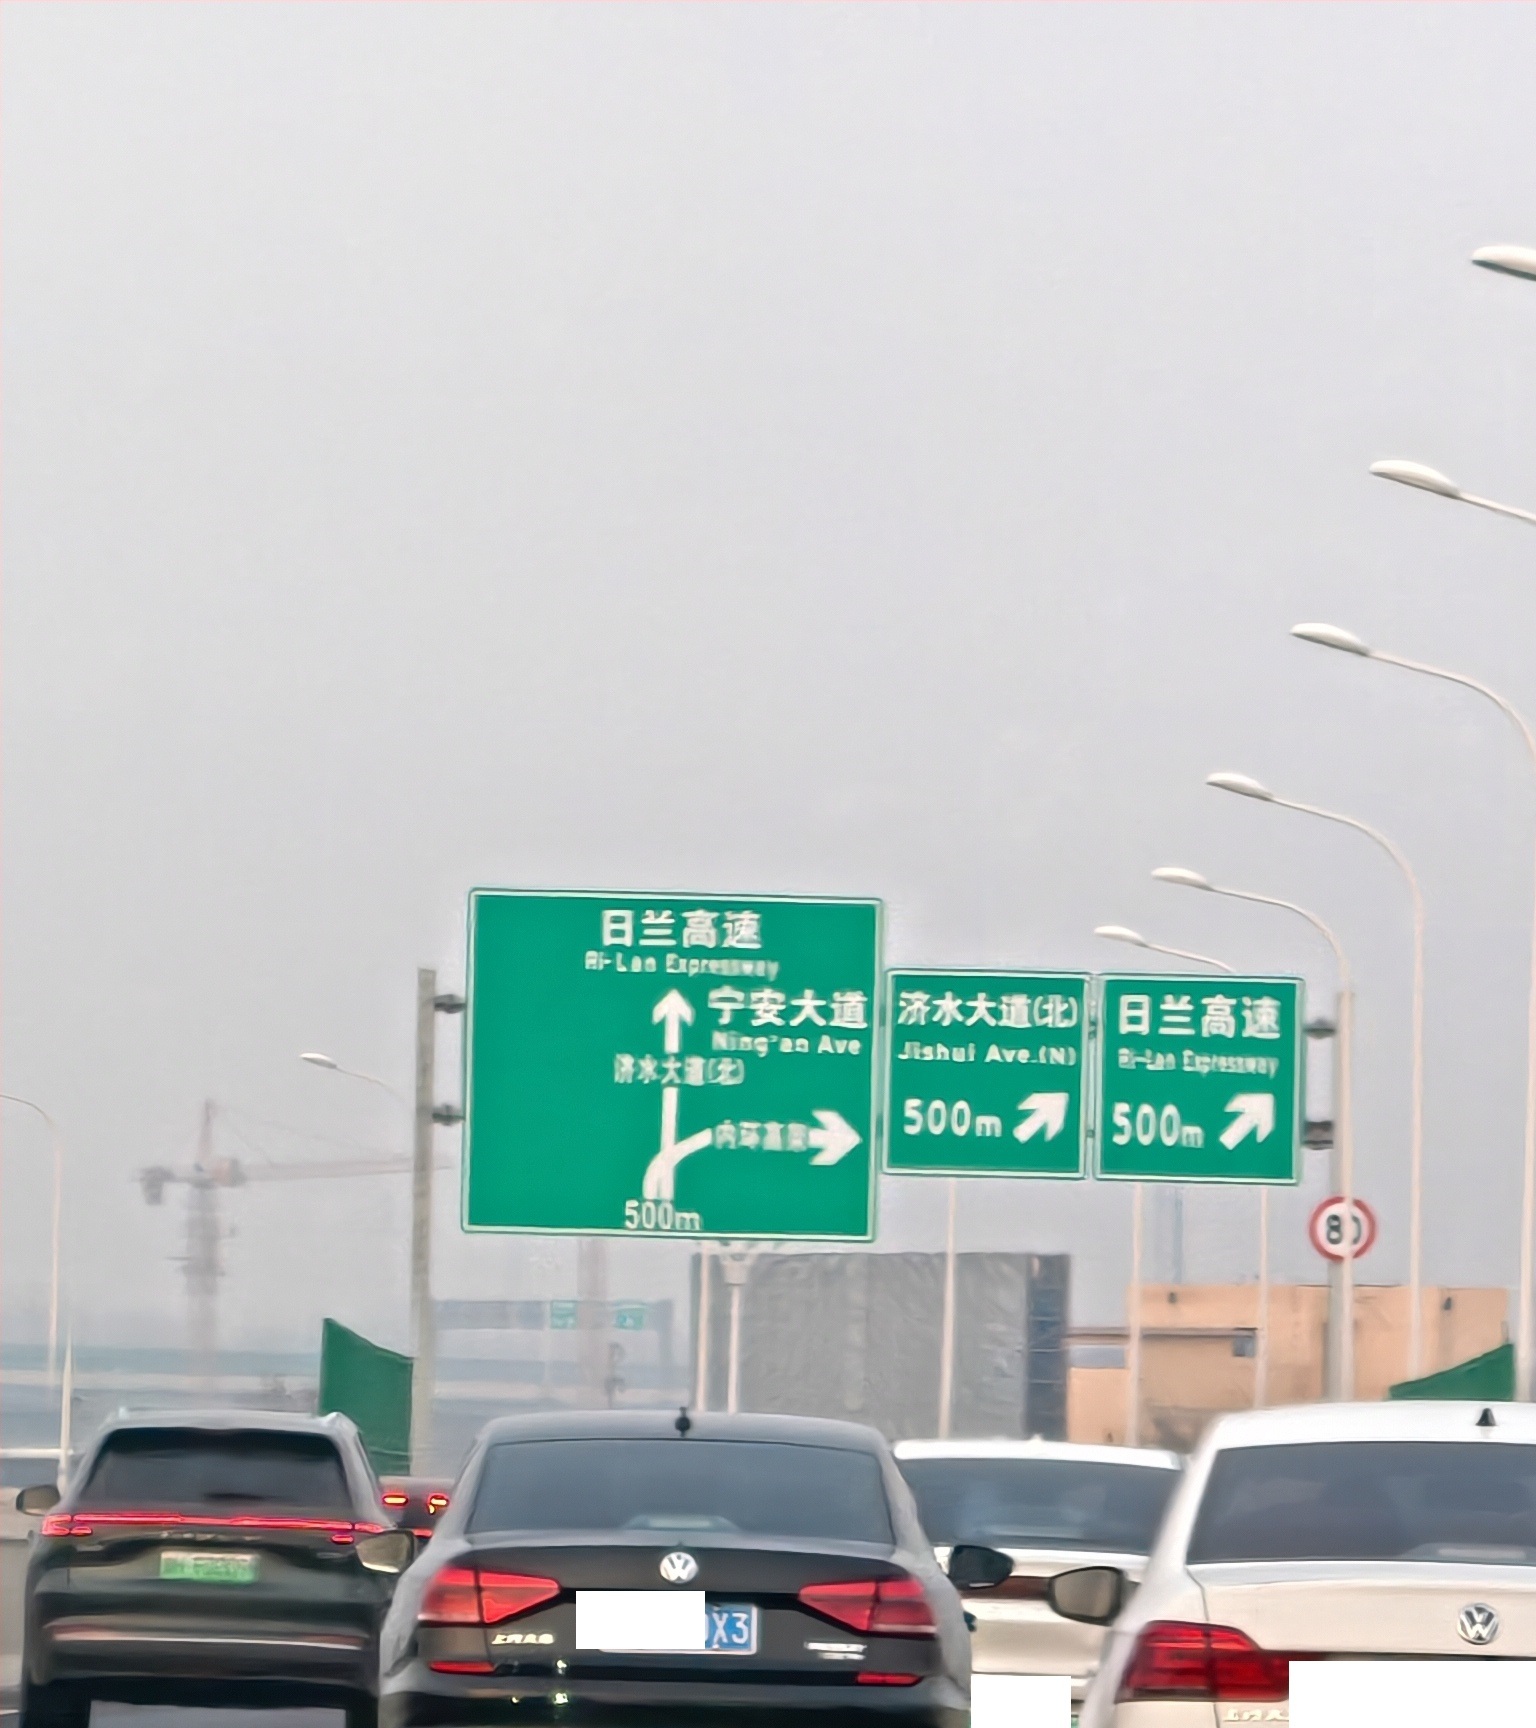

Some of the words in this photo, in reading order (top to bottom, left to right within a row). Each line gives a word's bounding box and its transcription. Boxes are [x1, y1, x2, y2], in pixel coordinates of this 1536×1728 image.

[602, 909, 762, 949] 日兰高速
[707, 985, 869, 1029] 宁安大道
[1119, 994, 1282, 1040] 日兰高速
[897, 1041, 976, 1062] Jishui
[903, 1098, 1002, 1138] 500m
[1112, 1102, 1205, 1149] 500m
[624, 1200, 703, 1230] 500m
